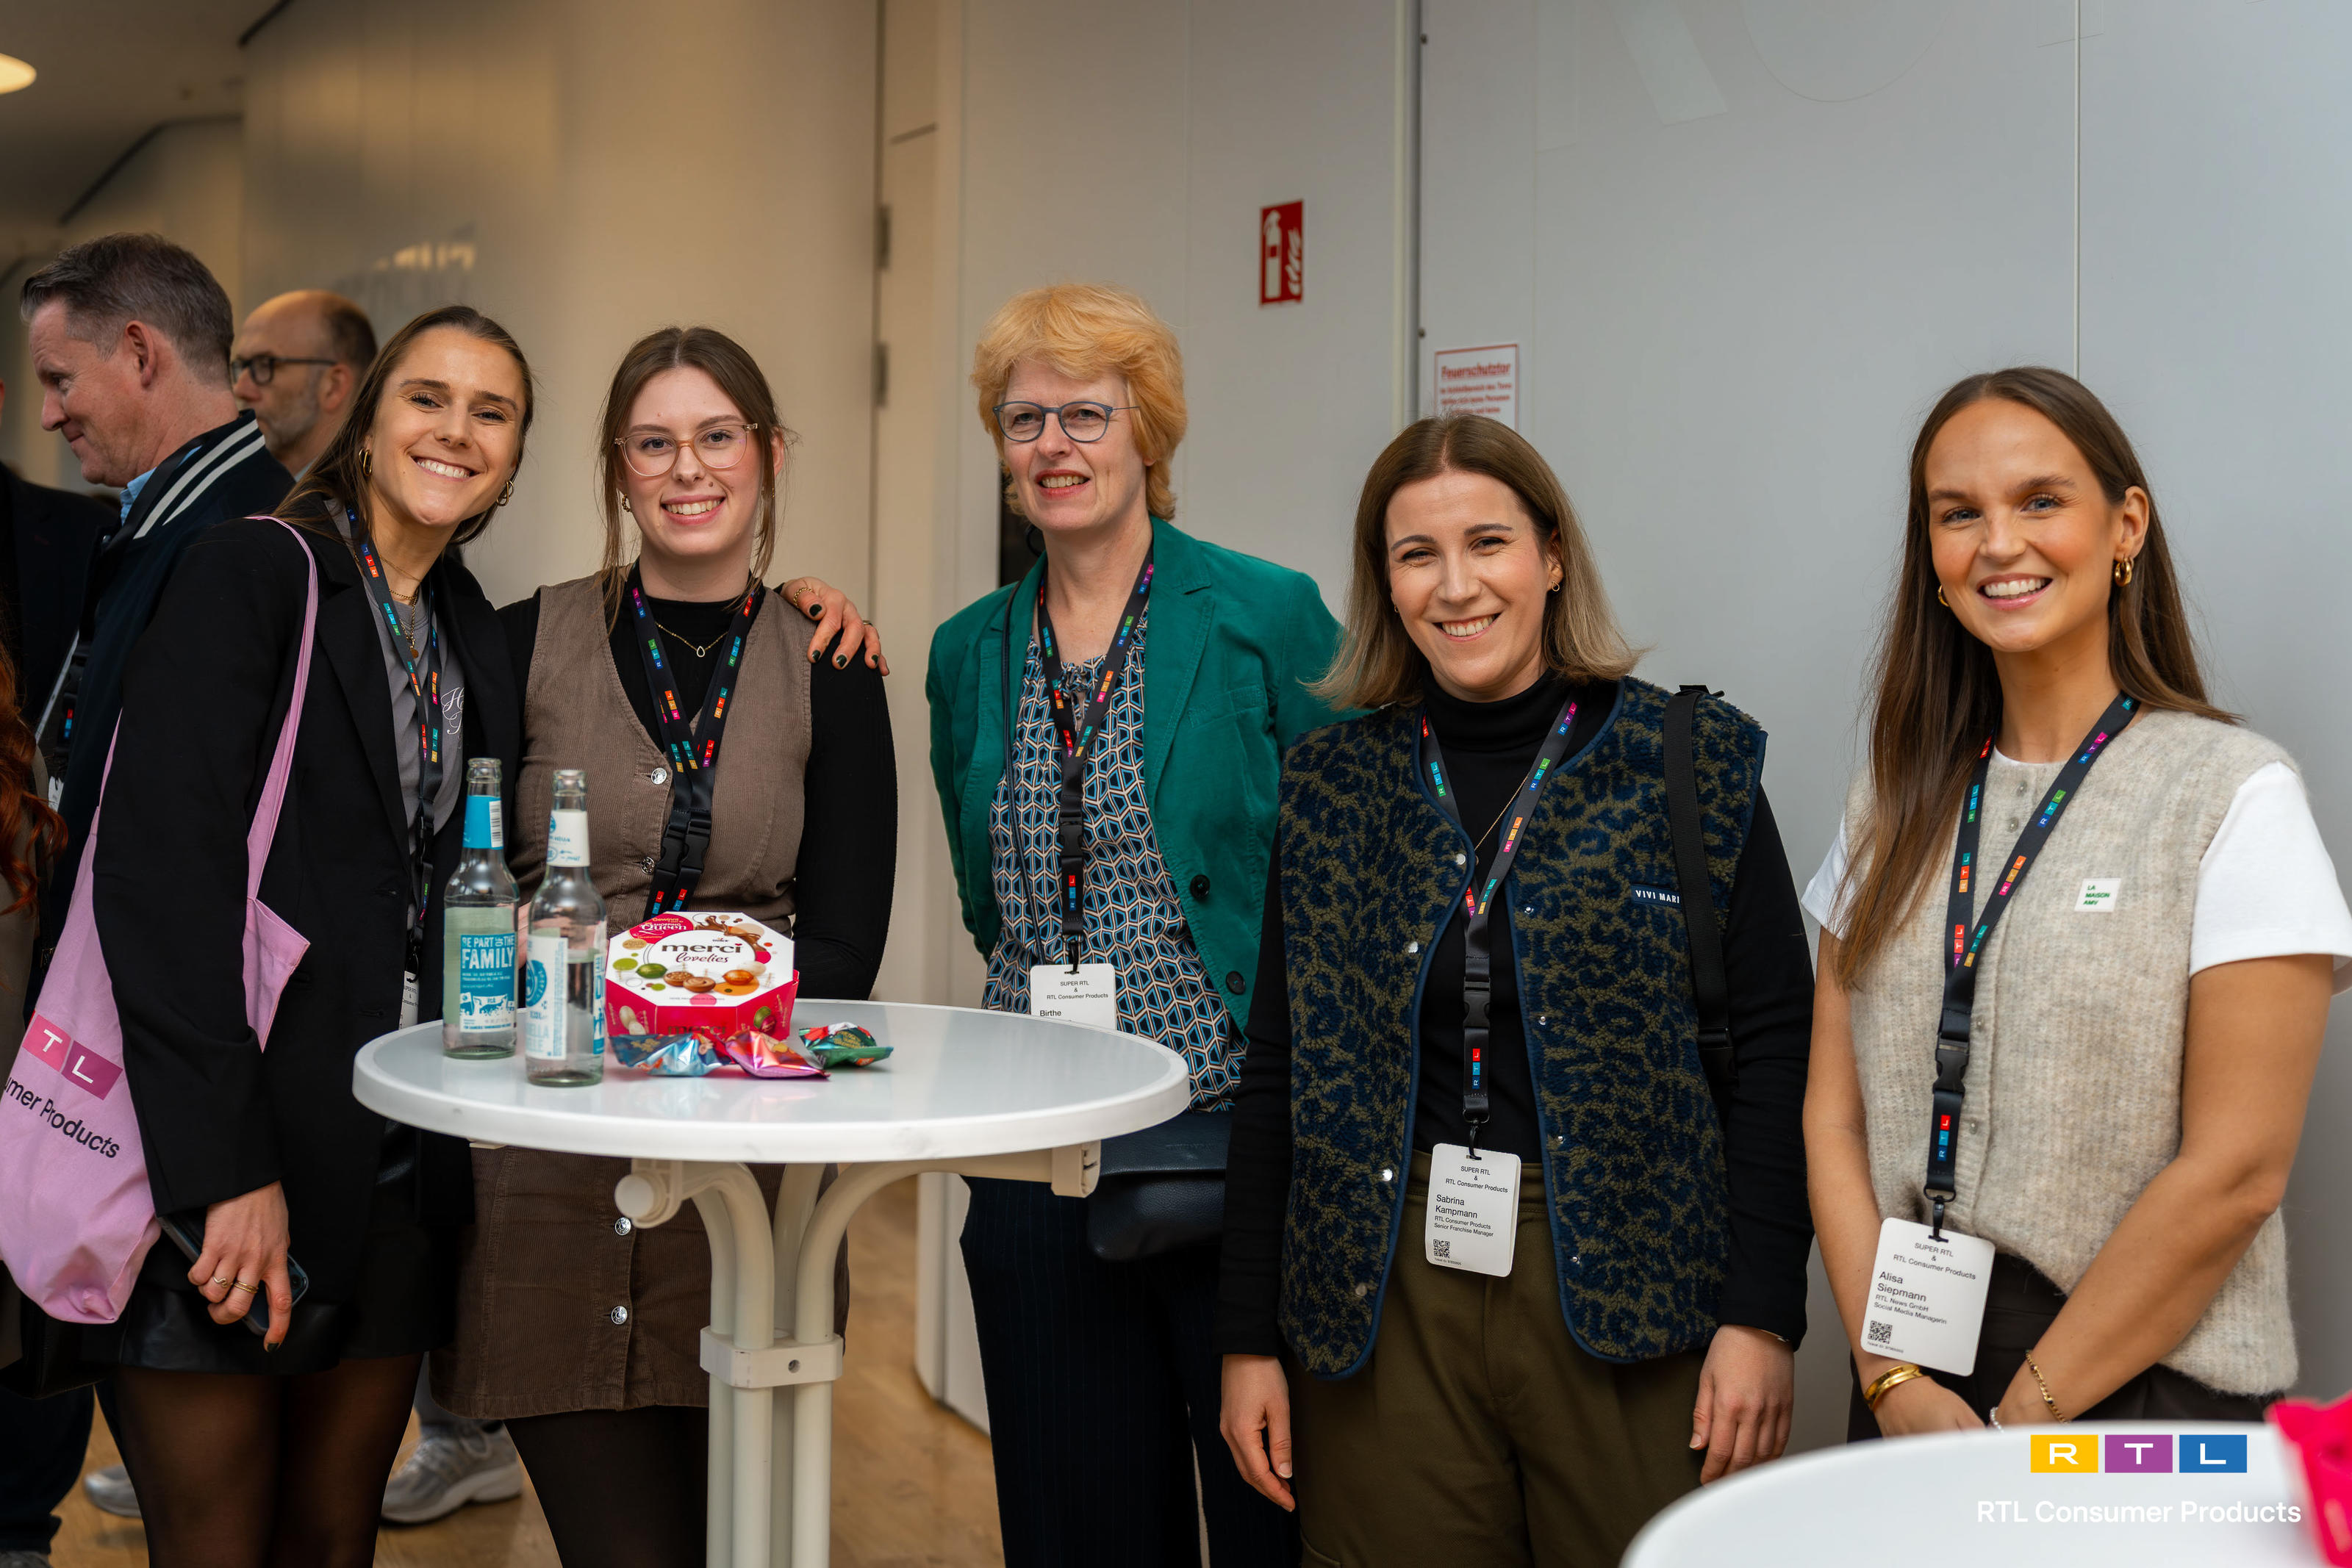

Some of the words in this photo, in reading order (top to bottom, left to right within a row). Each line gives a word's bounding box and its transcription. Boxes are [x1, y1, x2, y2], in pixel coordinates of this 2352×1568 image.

[1441, 362, 1511, 379] Feuerschutztor
[1635, 890, 1655, 899] VIVI
[1659, 893, 1679, 904] MARI
[641, 923, 686, 931] Queen
[474, 937, 494, 947] PART
[503, 935, 514, 946] THE
[662, 943, 742, 953] merci
[462, 947, 514, 968] FAMILY
[676, 952, 729, 963] lovelies
[40, 1098, 120, 1158] Products
[1460, 1165, 1479, 1173] SUPER
[1457, 1180, 1484, 1189] Consumer
[1484, 1184, 1508, 1193] Products
[1436, 1194, 1465, 1206] Sabrina
[1435, 1204, 1478, 1219] Kampmann
[1434, 1222, 1449, 1230] Senior
[1449, 1225, 1472, 1234] Franchise
[1473, 1229, 1494, 1237] Manager
[1445, 1217, 1469, 1226] Consumer
[1469, 1220, 1491, 1230] Products
[1915, 1242, 1939, 1254] SUPER
[1940, 1248, 1954, 1257] RTL
[1893, 1254, 1907, 1263] RTL
[1908, 1258, 1944, 1272] Consumer
[1946, 1267, 1976, 1280] Products
[1879, 1271, 1904, 1284] Alisa
[1877, 1283, 1926, 1302] Siepmann
[1875, 1294, 1888, 1302] RTL
[1890, 1298, 1907, 1307] News
[1908, 1302, 1929, 1312] GmbH
[1874, 1301, 1893, 1312] Social
[1893, 1306, 1913, 1317] Media
[1914, 1312, 1947, 1325] Managerin
